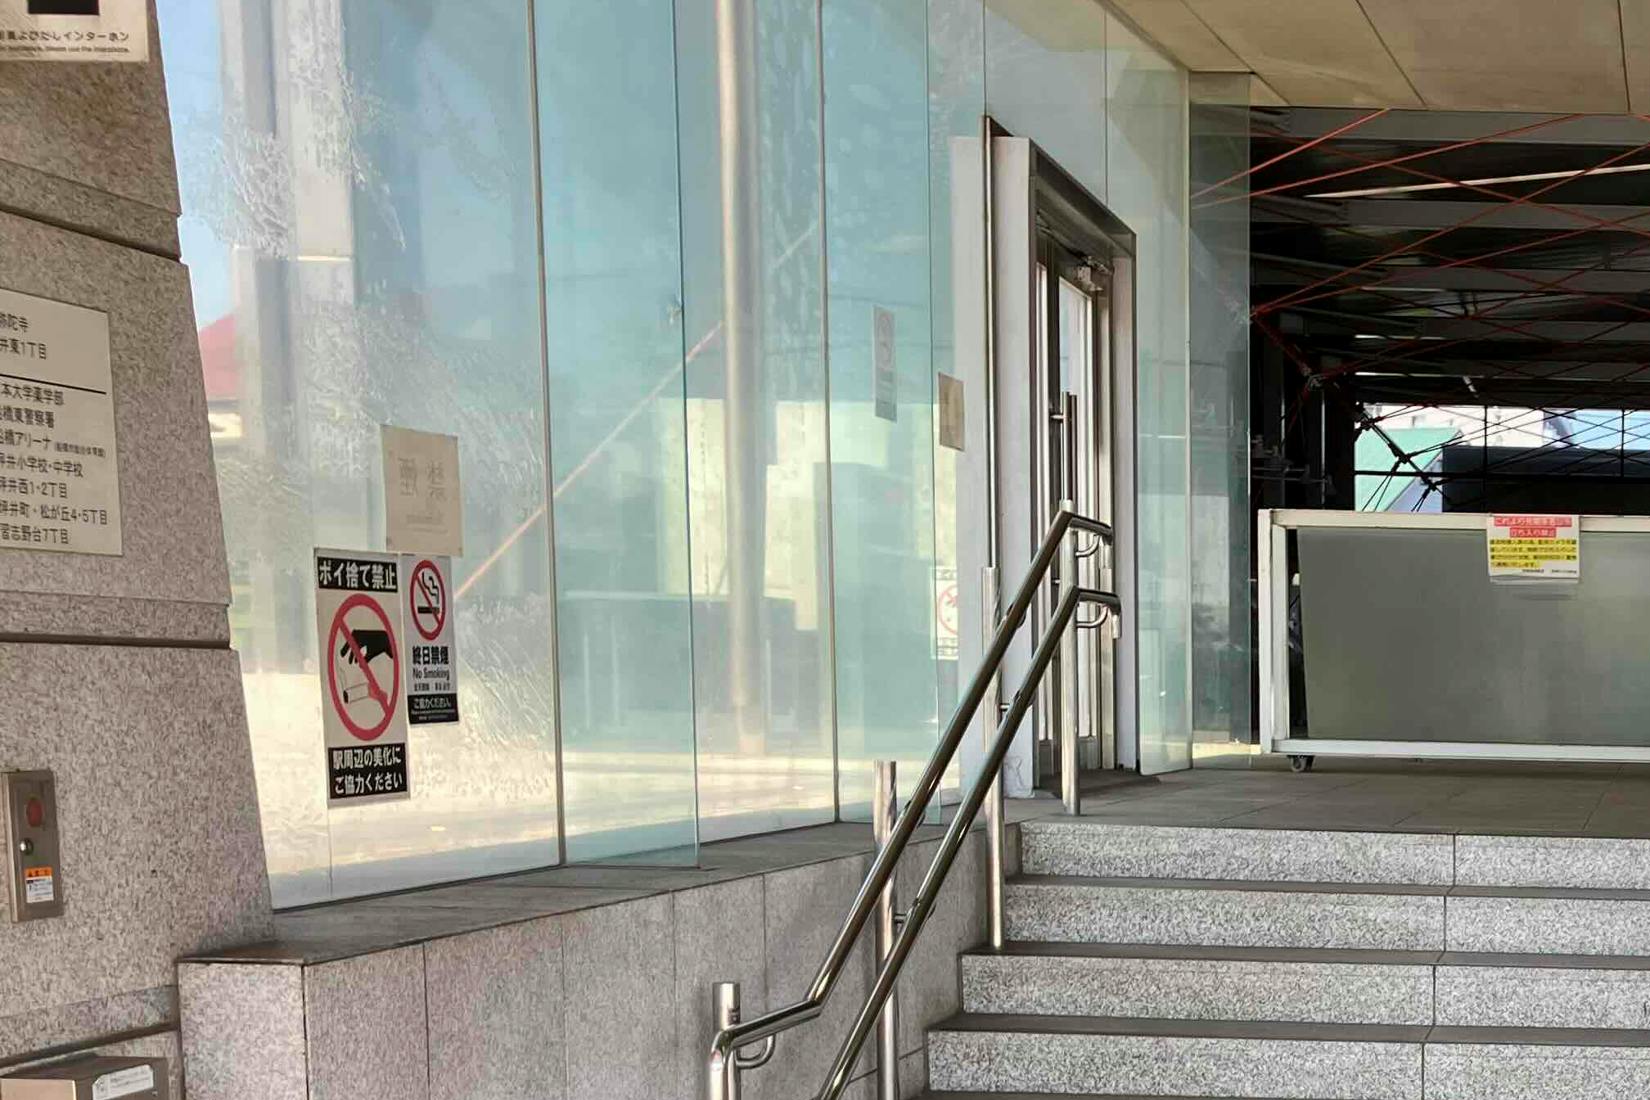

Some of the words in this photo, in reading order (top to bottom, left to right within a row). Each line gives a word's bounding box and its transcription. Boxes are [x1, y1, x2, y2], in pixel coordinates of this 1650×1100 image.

[0, 30, 129, 42] 員よびだしインターホン
[0, 405, 55, 428] 橋東警察署
[318, 562, 397, 590] ポイ捨て禁止
[412, 645, 450, 666] 終日禁煙
[412, 668, 422, 680] No
[424, 667, 450, 681] Smoking
[332, 746, 402, 770] 駅周辺の美化に
[334, 772, 403, 795] ご協力ください
